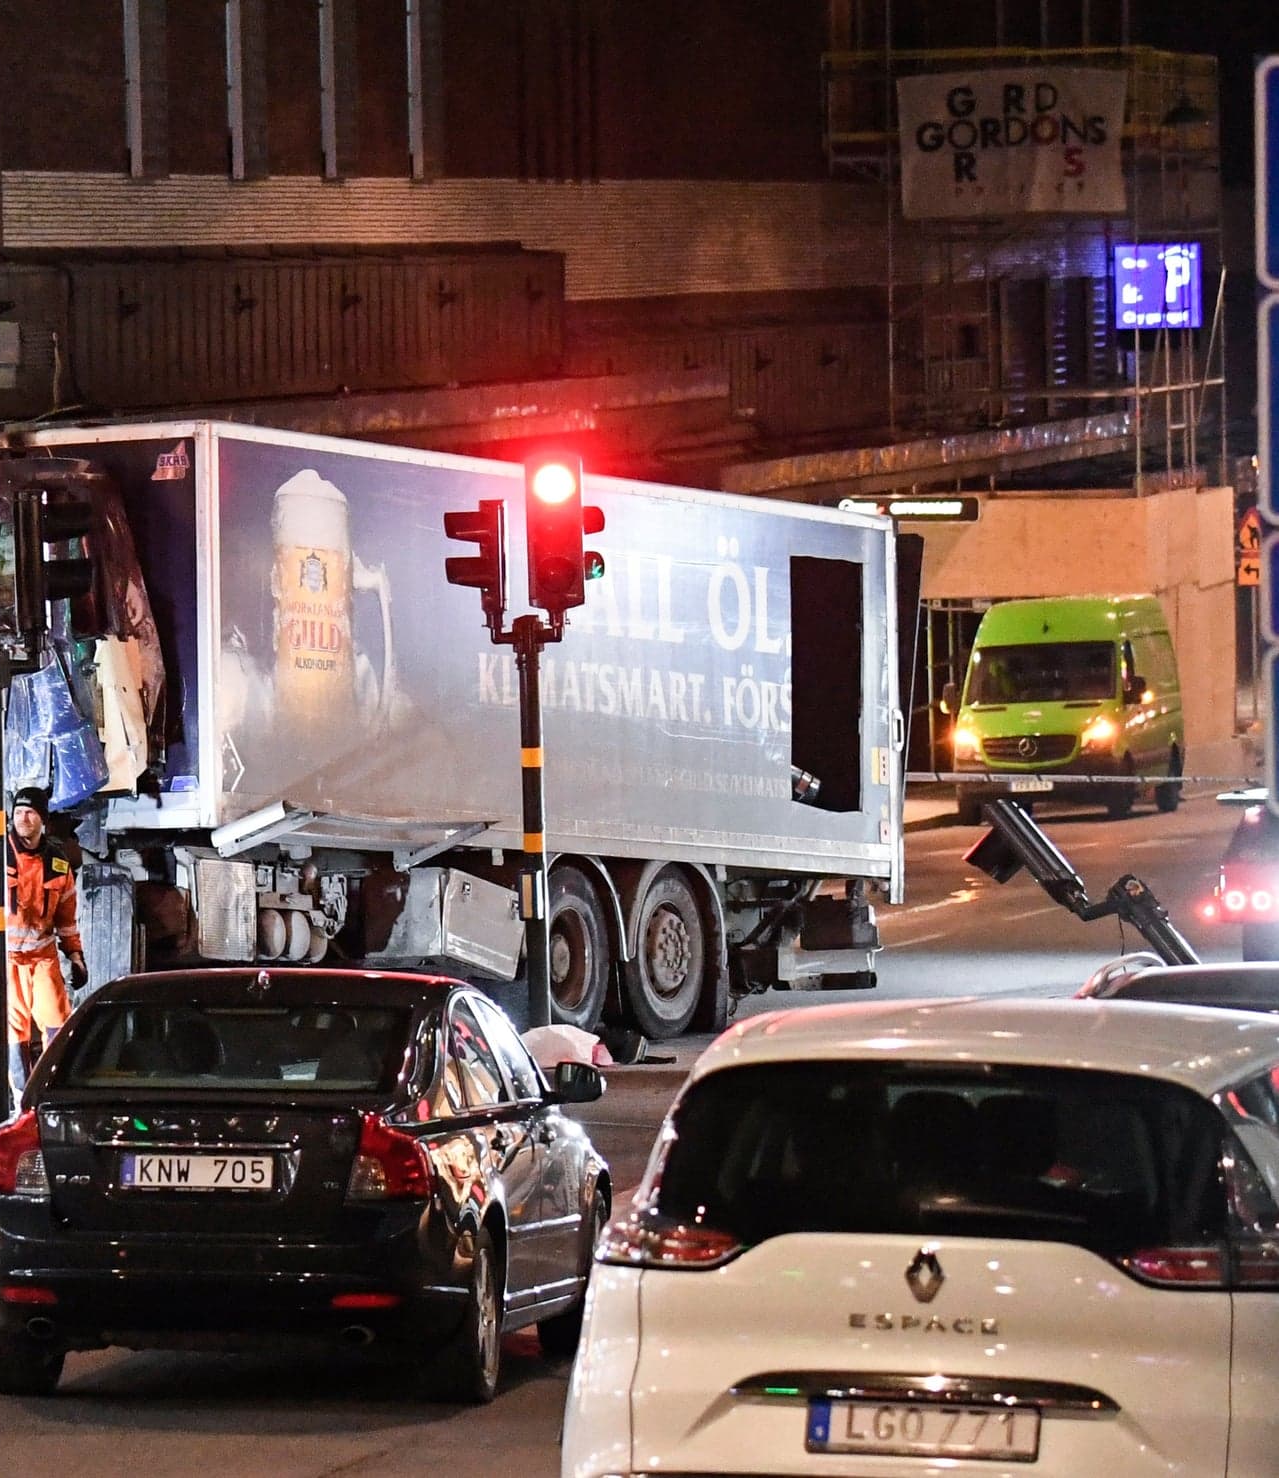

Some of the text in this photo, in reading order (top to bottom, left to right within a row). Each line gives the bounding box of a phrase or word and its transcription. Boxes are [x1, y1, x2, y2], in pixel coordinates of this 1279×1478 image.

[946, 86, 977, 117] G
[916, 114, 1109, 152] GORDONS
[1064, 148, 1086, 178] S
[570, 550, 686, 644] ALL
[478, 652, 712, 723] KLATSMART.
[139, 1158, 266, 1185] KNW 705
[849, 1313, 999, 1335] ESPACE
[845, 1403, 1015, 1447] LGO 771
